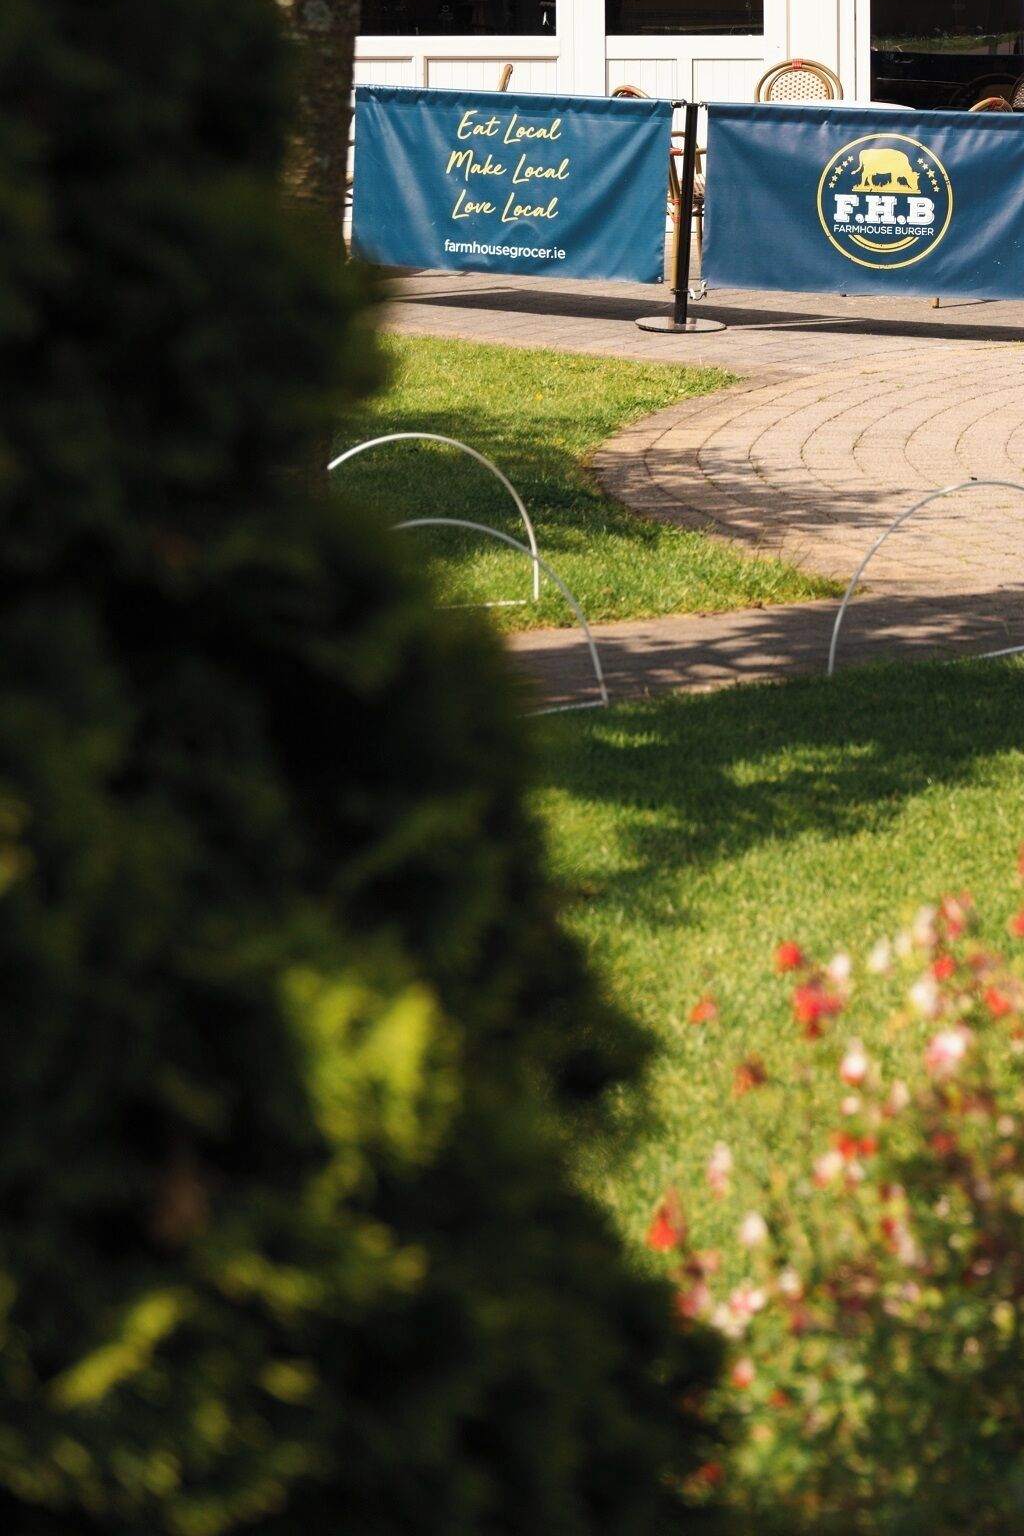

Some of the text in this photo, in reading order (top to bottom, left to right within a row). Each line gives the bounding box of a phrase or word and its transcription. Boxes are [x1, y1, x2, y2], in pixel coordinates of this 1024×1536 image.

[457, 110, 562, 144] Eat Local
[446, 149, 570, 184] Make Local
[452, 189, 559, 222] Love Local
[833, 194, 935, 225] F.H.B
[833, 224, 934, 236] FARMHOUSE BURGER
[444, 239, 566, 259] farmhousegrocer.ie
